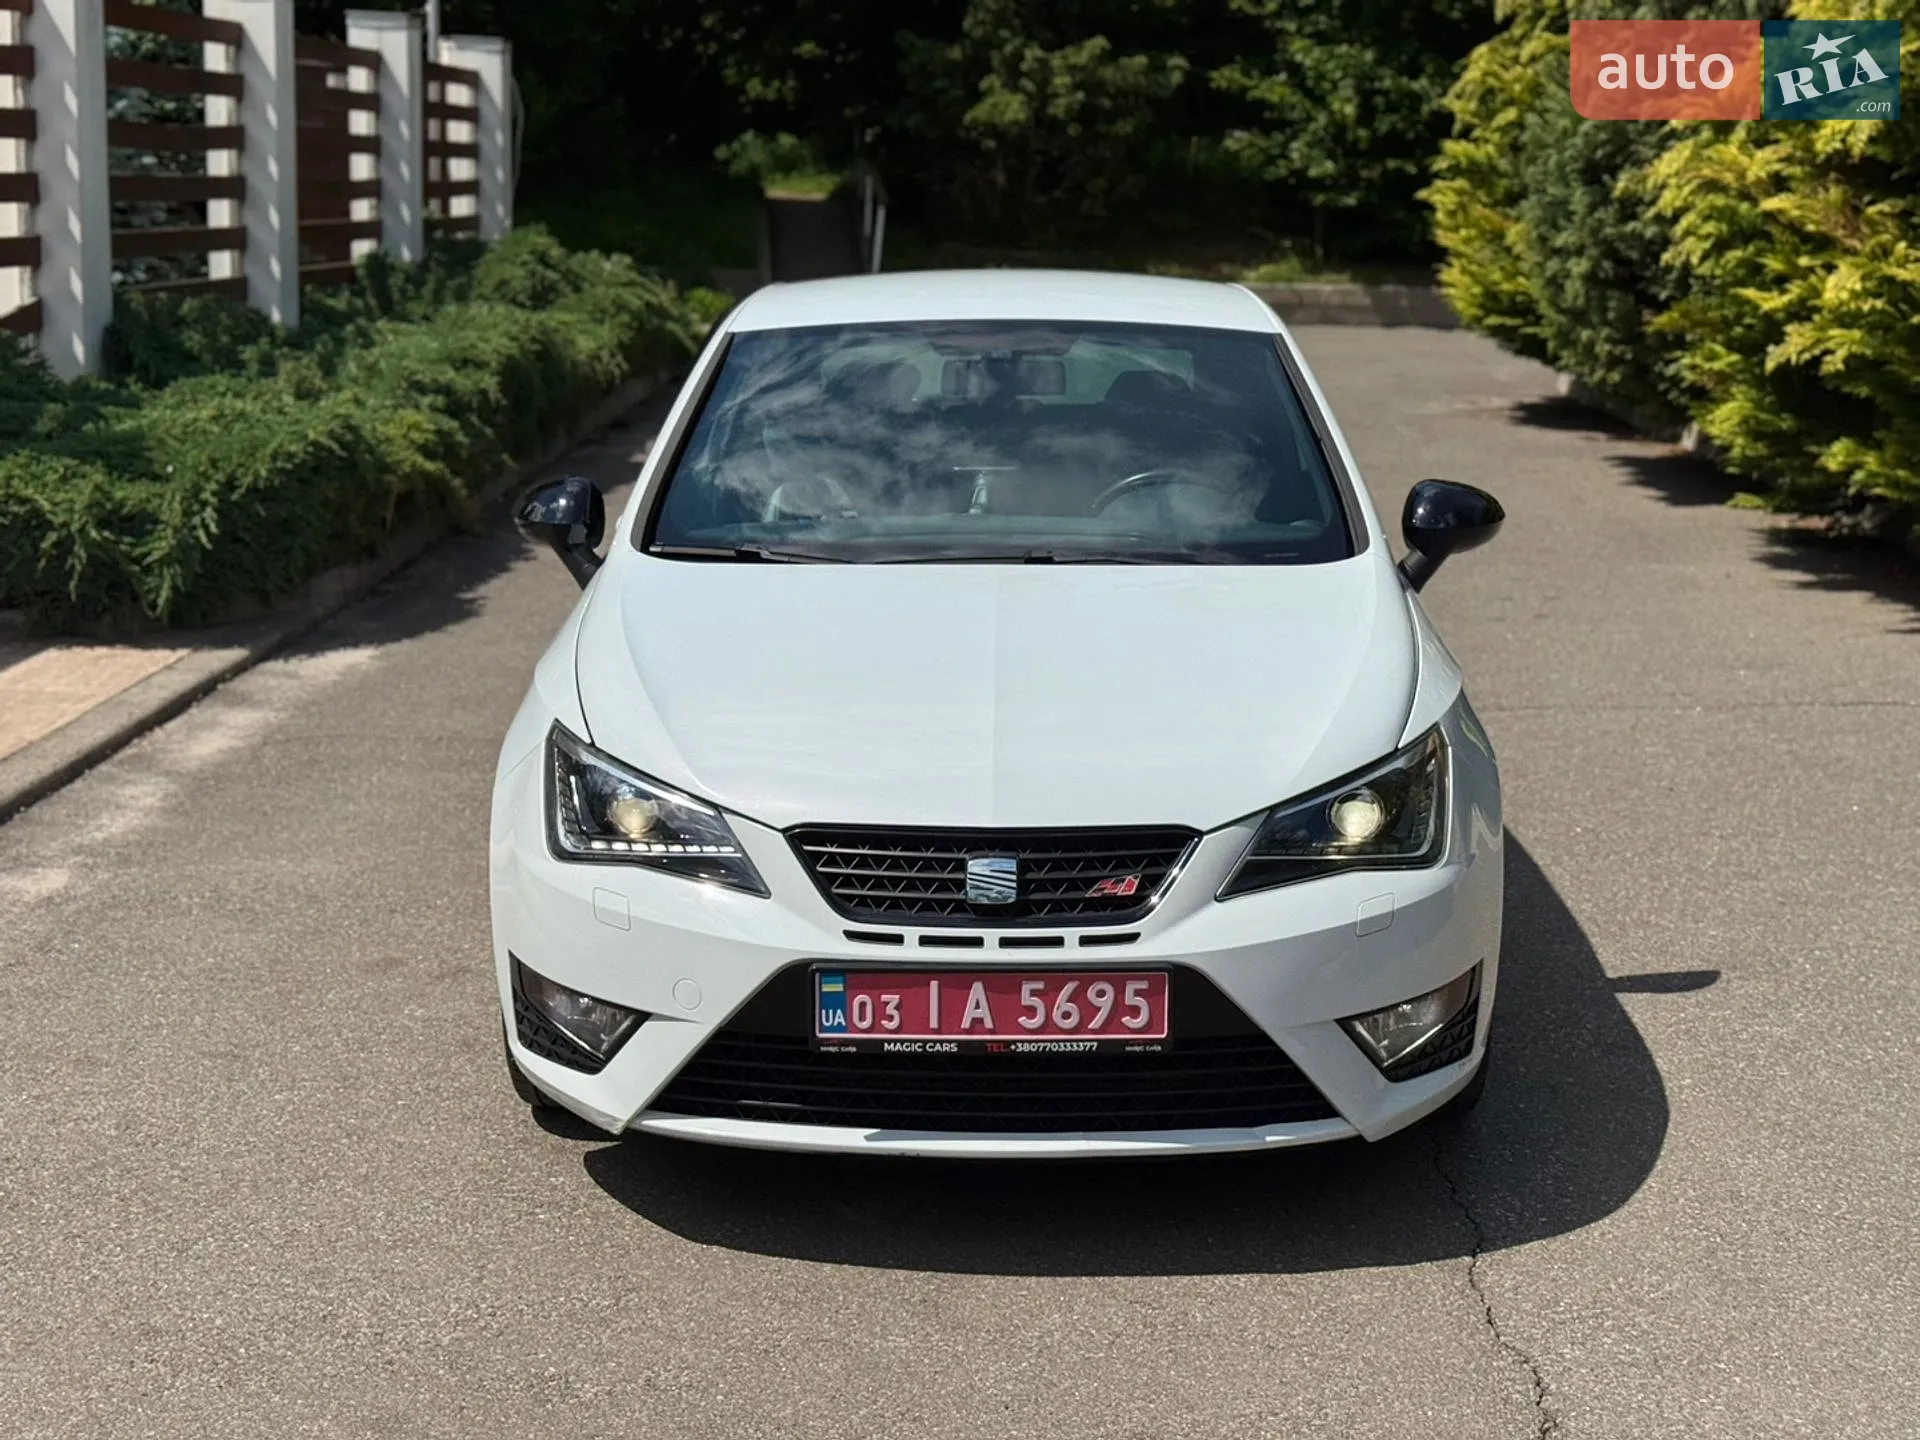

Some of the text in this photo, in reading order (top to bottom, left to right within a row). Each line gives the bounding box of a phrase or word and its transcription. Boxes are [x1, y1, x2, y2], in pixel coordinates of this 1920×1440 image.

[852, 994, 902, 1030] 03
[1018, 980, 1150, 1030] 5695
[822, 1009, 846, 1027] UA
[884, 1042, 958, 1052] MAGIC CARS
